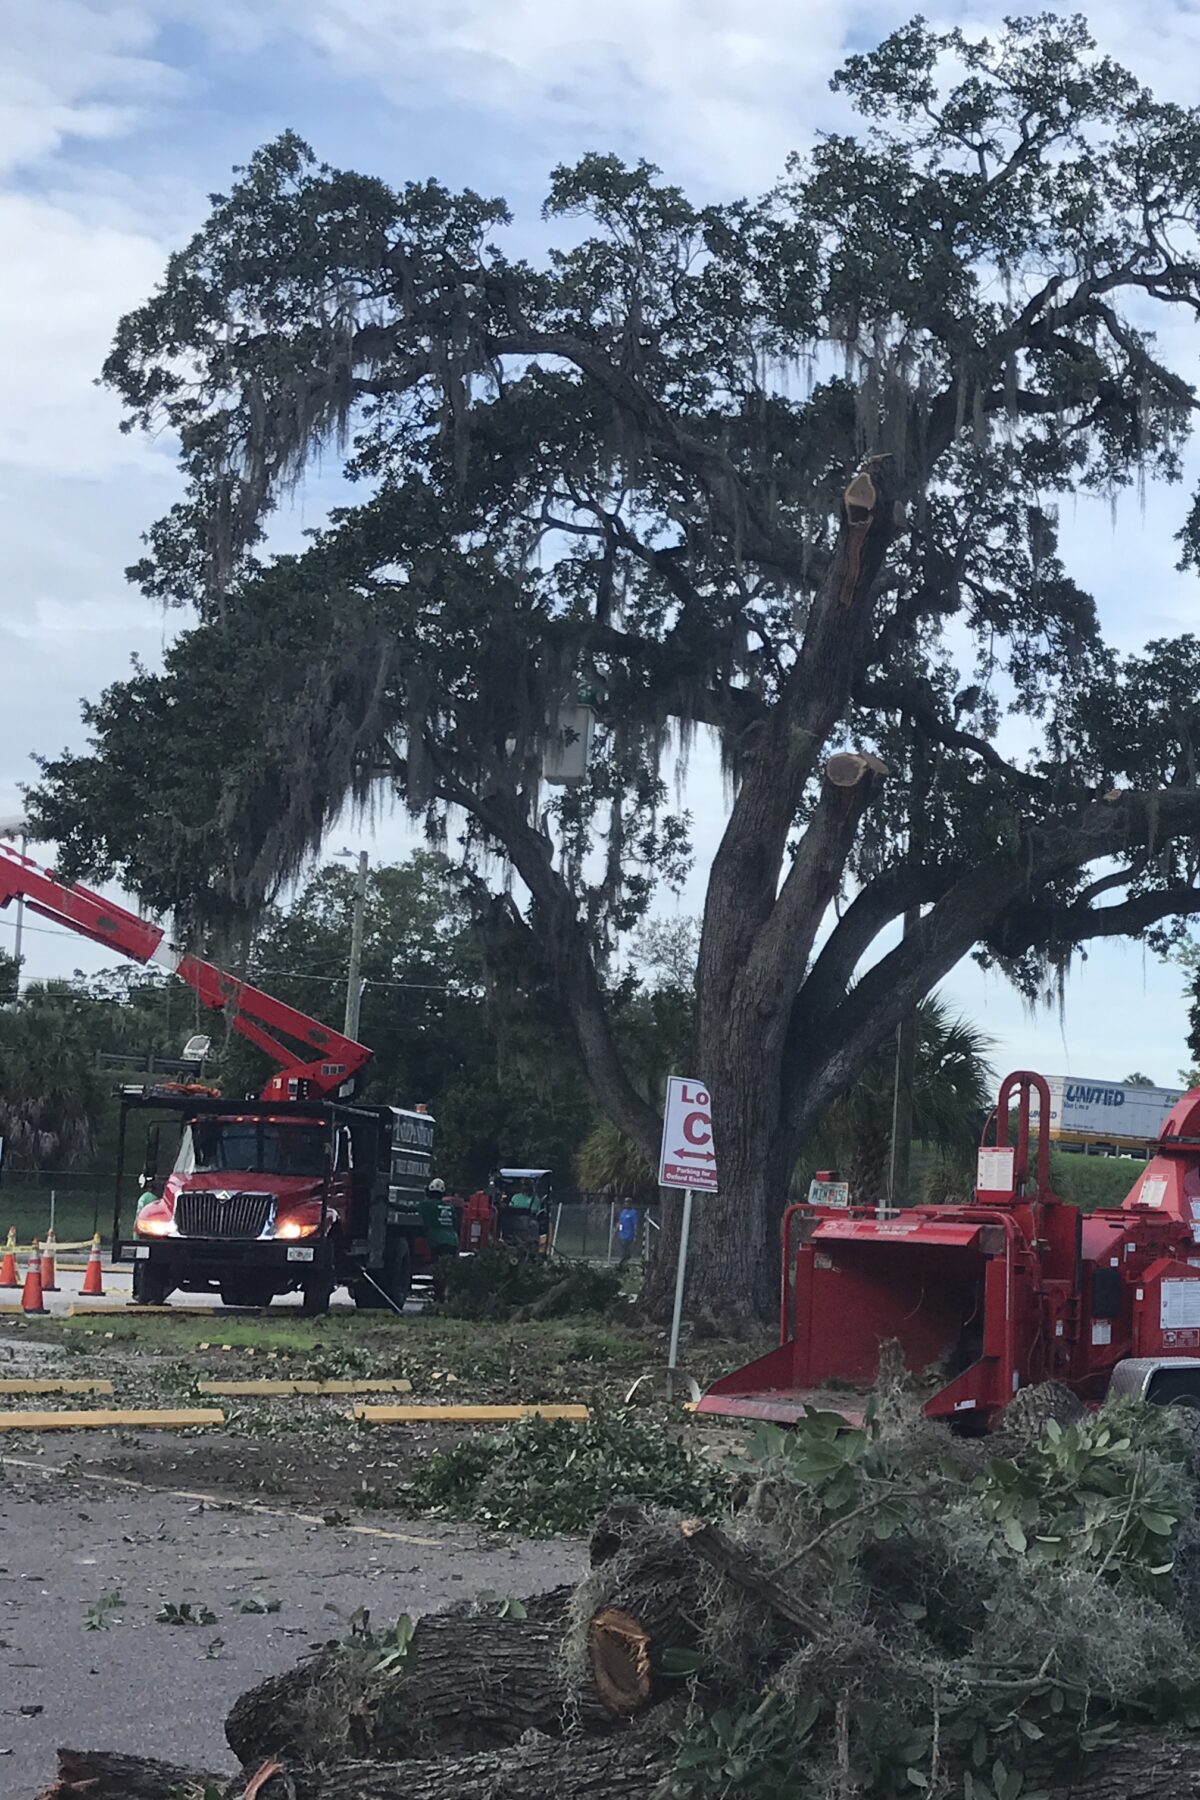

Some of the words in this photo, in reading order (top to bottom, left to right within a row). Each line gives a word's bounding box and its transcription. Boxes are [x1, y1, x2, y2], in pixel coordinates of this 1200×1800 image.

[1066, 1086, 1125, 1106] UNITED
[666, 1172, 688, 1181] Oxford
[676, 1167, 700, 1177] Parking
